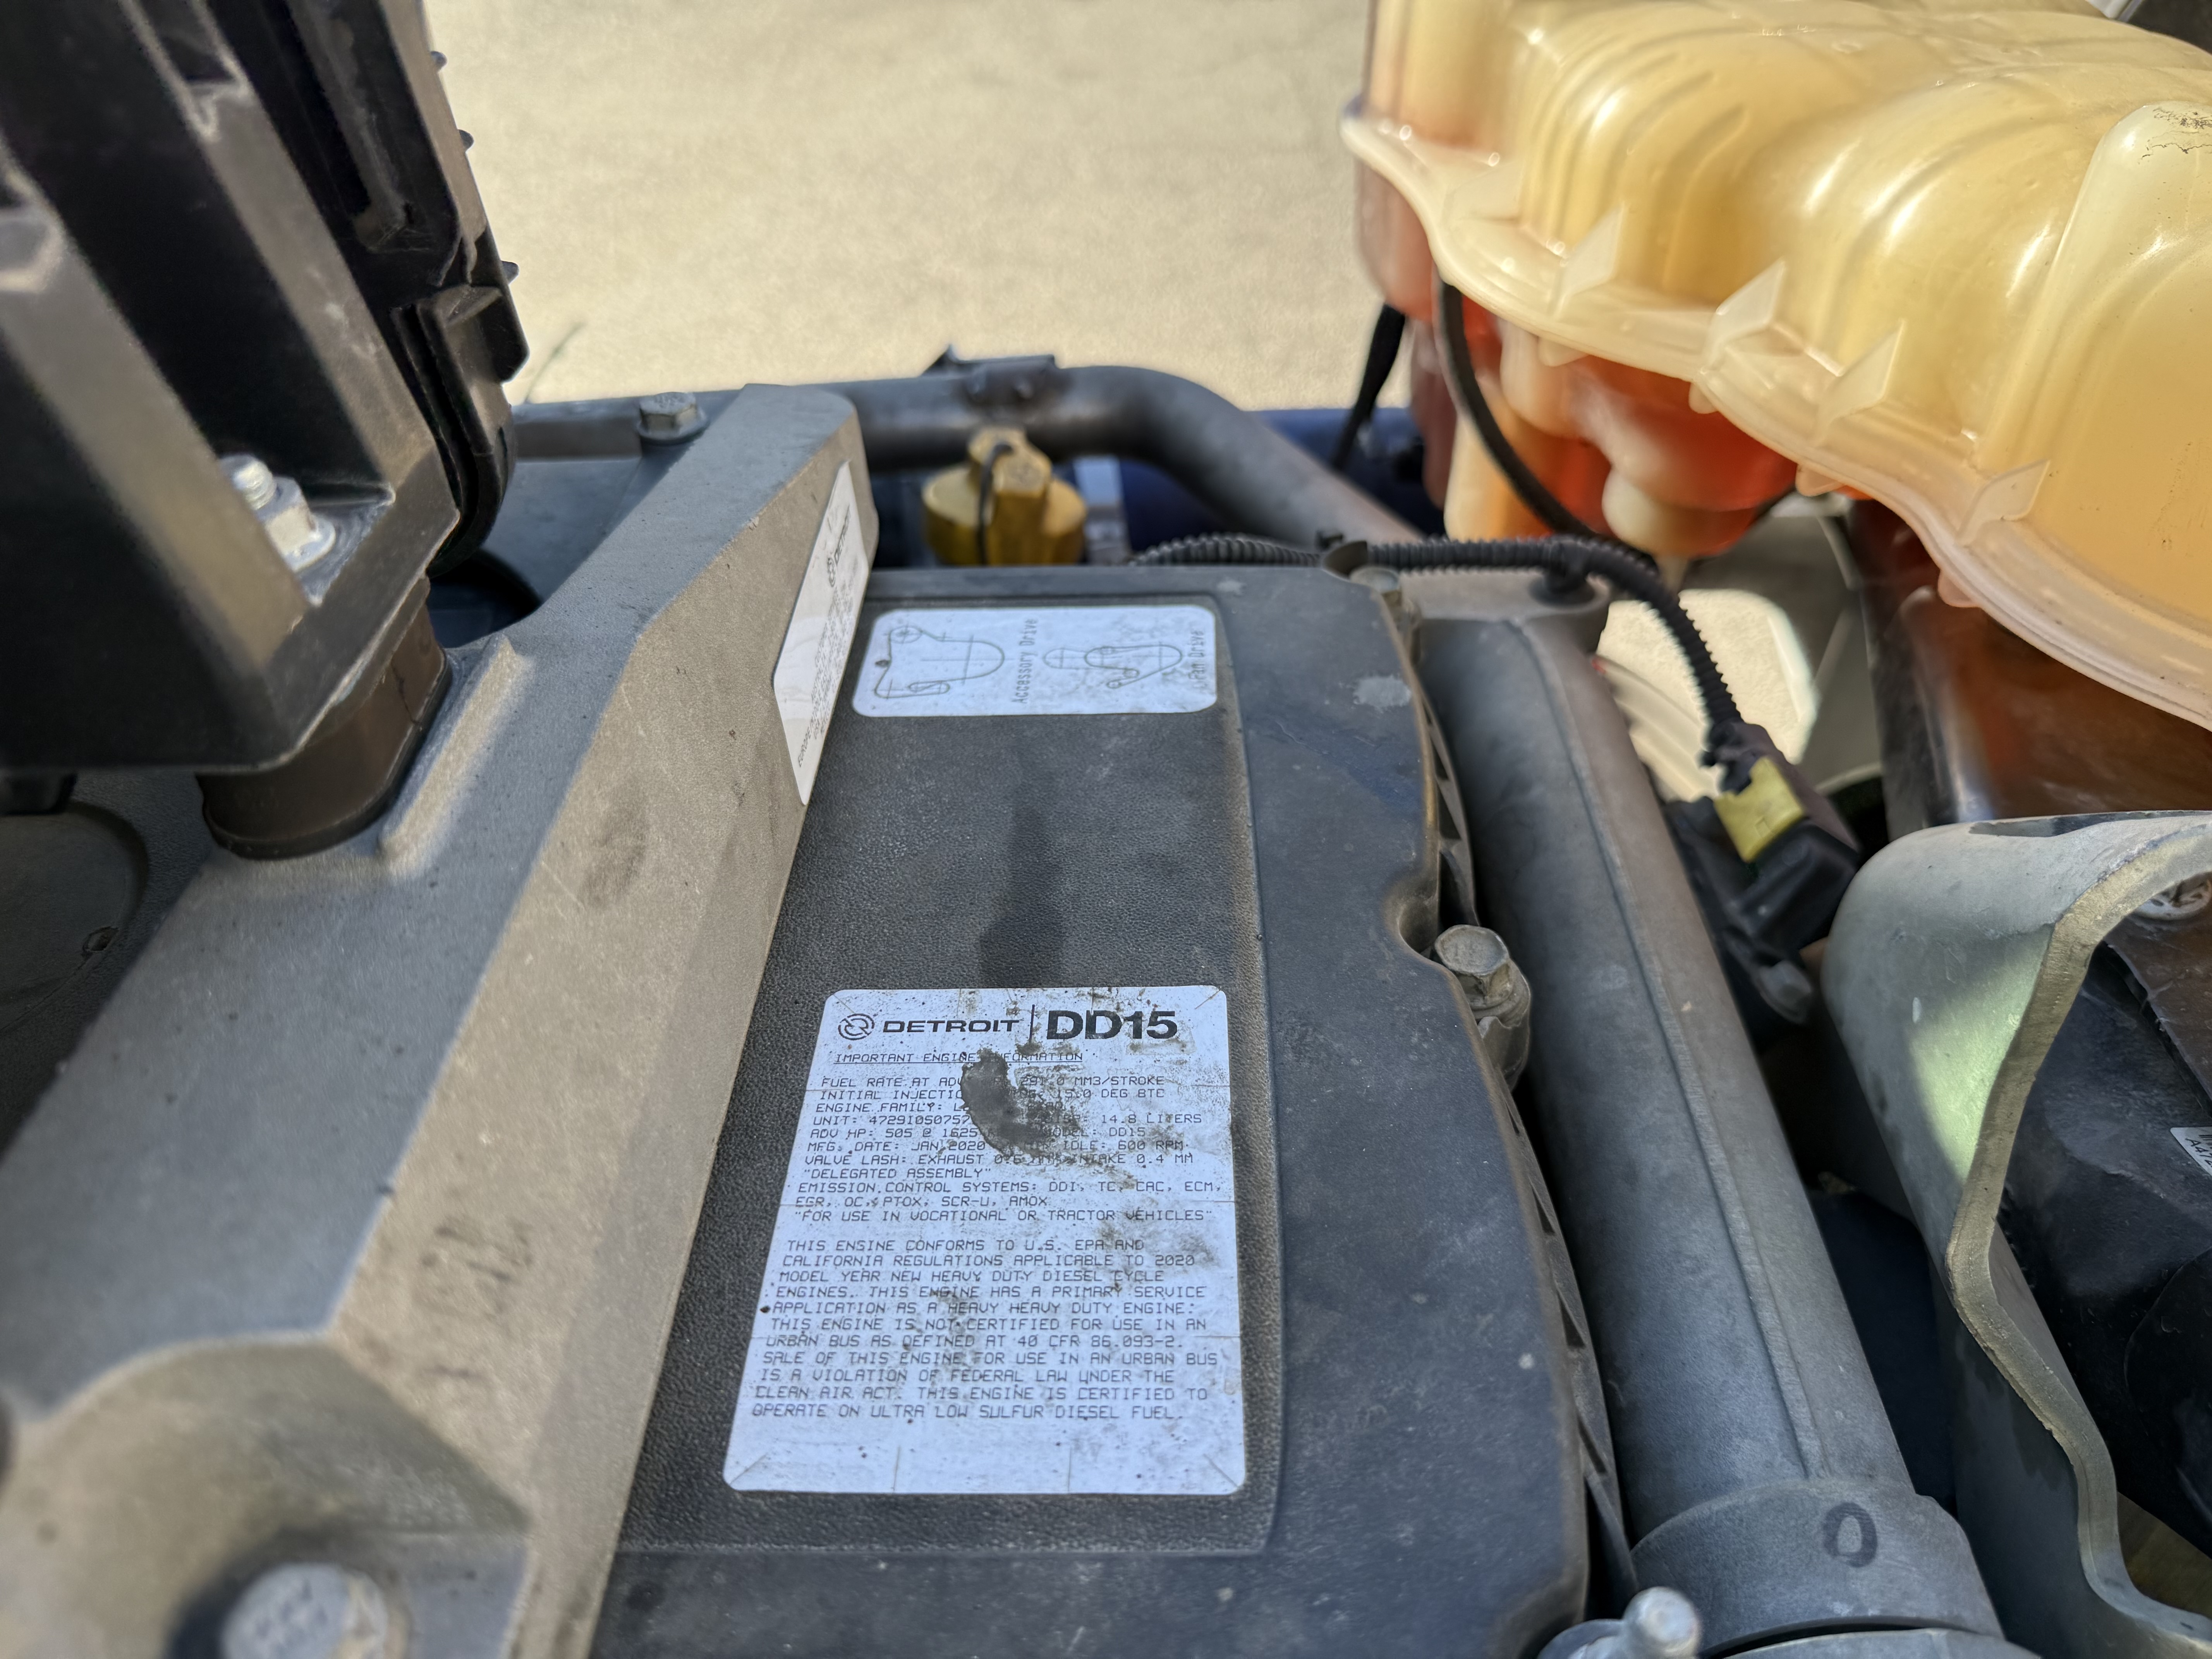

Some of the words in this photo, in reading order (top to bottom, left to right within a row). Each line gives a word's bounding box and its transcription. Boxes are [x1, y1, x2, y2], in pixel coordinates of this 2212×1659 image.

[1018, 619, 1037, 646] Drive
[1188, 630, 1204, 658] Drive
[1012, 652, 1037, 704] Accessory
[883, 1020, 1020, 1033] DETROIT
[1046, 1010, 1178, 1040] DD15
[837, 1054, 913, 1062] IMPORTANT
[923, 1053, 976, 1061] ENGINE
[987, 1053, 1083, 1061] NFORMATION
[821, 1078, 856, 1087] FUEL
[867, 1077, 902, 1086] RATE
[912, 1077, 929, 1086] AT
[1075, 1077, 1165, 1085] MM3/STROKE
[821, 1091, 883, 1099] INITIAL
[894, 1091, 962, 1099] INJECTIO
[1101, 1089, 1128, 1098] DEG
[1138, 1089, 1164, 1097] BTC
[816, 1103, 871, 1112] ENGINE
[880, 1103, 943, 1111] FAMILY:
[813, 1116, 859, 1125] UNIT:
[1102, 1115, 1137, 1123] 14.8
[1147, 1115, 1202, 1123] LITERS
[811, 1129, 838, 1138] ADV
[848, 1129, 874, 1137] HP:
[886, 1129, 912, 1137] 505
[922, 1128, 932, 1137] @
[943, 1128, 978, 1137] 1625
[1109, 1128, 1146, 1136] DD15
[855, 1142, 900, 1151] DATE:
[912, 1142, 939, 1151] JAN
[948, 1142, 986, 1150] 2020
[1064, 1141, 1108, 1150] IDLE:
[1118, 1141, 1146, 1150] 600
[1156, 1141, 1184, 1150] RPM
[805, 1155, 850, 1164] VALVE
[861, 1155, 908, 1164] LASH:
[918, 1155, 984, 1164] EXHAUST
[1137, 1154, 1164, 1163] 0.4
[1175, 1154, 1193, 1163] MM
[885, 1182, 950, 1192] CONTROL
[963, 1182, 1038, 1192] SYSTEMS:
[1049, 1182, 1084, 1192] DDI,
[1100, 1182, 1124, 1192] TC,
[1136, 1182, 1171, 1191] CAC,
[1185, 1182, 1220, 1191] ECM,
[795, 1197, 831, 1207] EGR,
[883, 1197, 929, 1206] PTOX,
[941, 1196, 996, 1206] SCR-U,
[1009, 1196, 1048, 1206] AMOX
[842, 1211, 869, 1221] USE
[883, 1211, 900, 1221] IN
[910, 1211, 1005, 1221] VOCATIONAL
[1018, 1211, 1037, 1221] OR
[1050, 1210, 1115, 1220] TRACTOR
[789, 1240, 826, 1250] THIS
[836, 1240, 894, 1250] ENGINE
[905, 1240, 984, 1250] CONFORMS
[998, 1240, 1015, 1250] TO
[1026, 1240, 1062, 1250] U.S.
[1075, 1240, 1105, 1250] EPA
[1115, 1240, 1144, 1250] AND
[783, 1255, 883, 1266] CALIFORNIA
[893, 1255, 1003, 1266] REGULATIONS
[1013, 1255, 1113, 1266] APPLICABLE
[1127, 1255, 1144, 1266] TO
[1155, 1255, 1195, 1266] 2020
[780, 1271, 828, 1281] MODEL
[842, 1271, 881, 1281] YEAR
[891, 1271, 921, 1281] NEW
[931, 1271, 982, 1281] HEAVY
[992, 1271, 1032, 1281] DUTY
[1043, 1271, 1103, 1281] DIESEL
[1115, 1271, 1163, 1281] CYCLE
[776, 1286, 855, 1298] ENGINES.
[870, 1286, 908, 1297] THIS
[919, 1286, 979, 1297] ENGINE
[992, 1286, 1021, 1297] HAS
[1033, 1286, 1041, 1297] A
[1053, 1286, 1124, 1297] PRIMARY
[1134, 1286, 1206, 1297] SERVICE
[772, 1302, 886, 1314] APPLICATION
[896, 1302, 917, 1314] AS
[927, 1302, 938, 1314] A
[948, 1302, 999, 1314] HEAVY
[1011, 1302, 1060, 1314] HEAVY
[1073, 1302, 1112, 1314] DUTY
[772, 1318, 811, 1330] THIS
[823, 1318, 883, 1330] ENGINE
[895, 1318, 917, 1330] IS
[927, 1318, 957, 1330] NOT
[968, 1318, 1060, 1330] CERTIFIED
[1071, 1318, 1103, 1330] FOR
[1113, 1319, 1142, 1330] USE
[1157, 1319, 1174, 1330] IN
[1186, 1319, 1206, 1330] AN
[766, 1335, 819, 1347] URBAN
[829, 1335, 860, 1347] BUS
[871, 1335, 891, 1347] AS
[902, 1335, 975, 1347] DEFINED
[986, 1335, 1006, 1347] AT
[1018, 1335, 1037, 1347] 40
[1049, 1335, 1080, 1347] CFR
[1091, 1335, 1182, 1348] 86.093-2.
[763, 1352, 803, 1364] SALE
[816, 1352, 835, 1364] OF
[849, 1352, 889, 1364] THIS
[899, 1352, 963, 1364] ENGINE
[974, 1352, 1005, 1364] FOR
[1016, 1352, 1047, 1365] USE
[1060, 1352, 1079, 1365] IN
[1091, 1352, 1111, 1365] AN
[1122, 1352, 1175, 1365] URBAN
[1187, 1352, 1217, 1365] BUS
[761, 1369, 781, 1381] IS
[792, 1369, 802, 1381] A
[812, 1369, 907, 1381] VIOLATION
[920, 1369, 939, 1382] OF
[952, 1369, 1025, 1382] FEDERAL
[1037, 1369, 1067, 1382] LAW
[1079, 1370, 1131, 1382] UNDER
[1145, 1370, 1174, 1382] THE
[755, 1386, 809, 1399] CLEAN
[819, 1386, 852, 1399] AIR
[919, 1386, 958, 1399] THIS
[970, 1387, 1034, 1399] ENGINE
[1048, 1387, 1066, 1400] IS
[1078, 1387, 1174, 1400] CERTIFIED
[1188, 1388, 1207, 1400] TO
[752, 1405, 826, 1417] OPERATE
[839, 1405, 860, 1418] ON
[871, 1405, 924, 1418] ULTRA
[937, 1405, 968, 1418] LOW
[980, 1405, 1044, 1419] SULFUR
[1055, 1406, 1120, 1419] DIESEL
[1132, 1406, 1182, 1419] FUEL.
